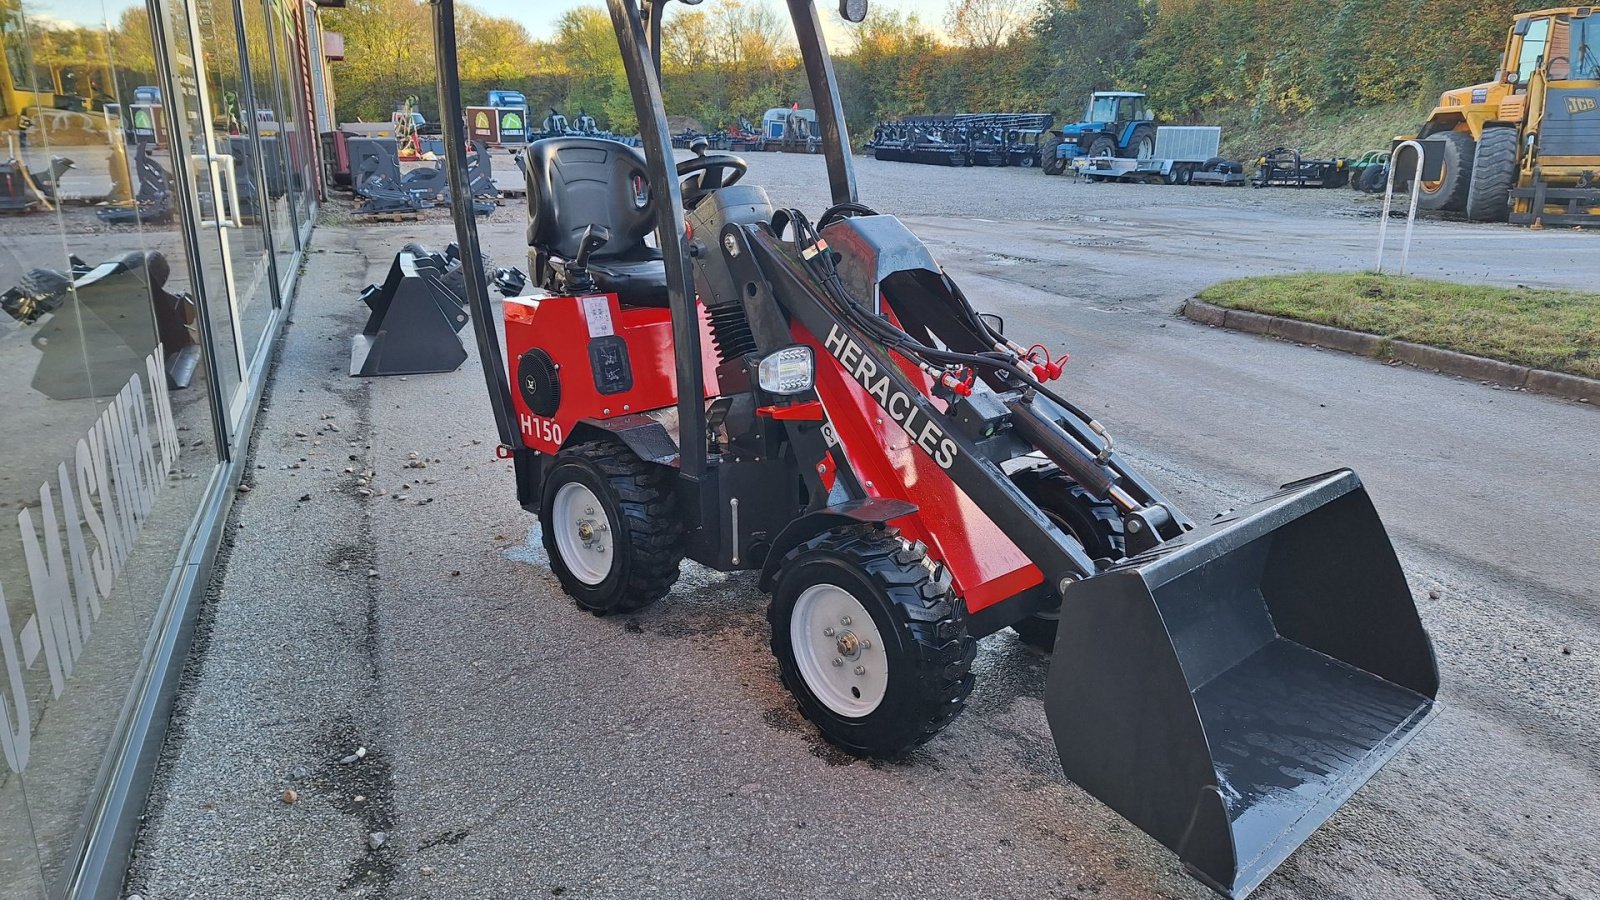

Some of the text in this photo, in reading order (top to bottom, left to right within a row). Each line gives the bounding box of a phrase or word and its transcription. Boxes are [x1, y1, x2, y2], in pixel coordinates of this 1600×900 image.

[1568, 97, 1595, 113] JCB
[824, 323, 958, 469] HERACLES
[520, 413, 562, 446] H150
